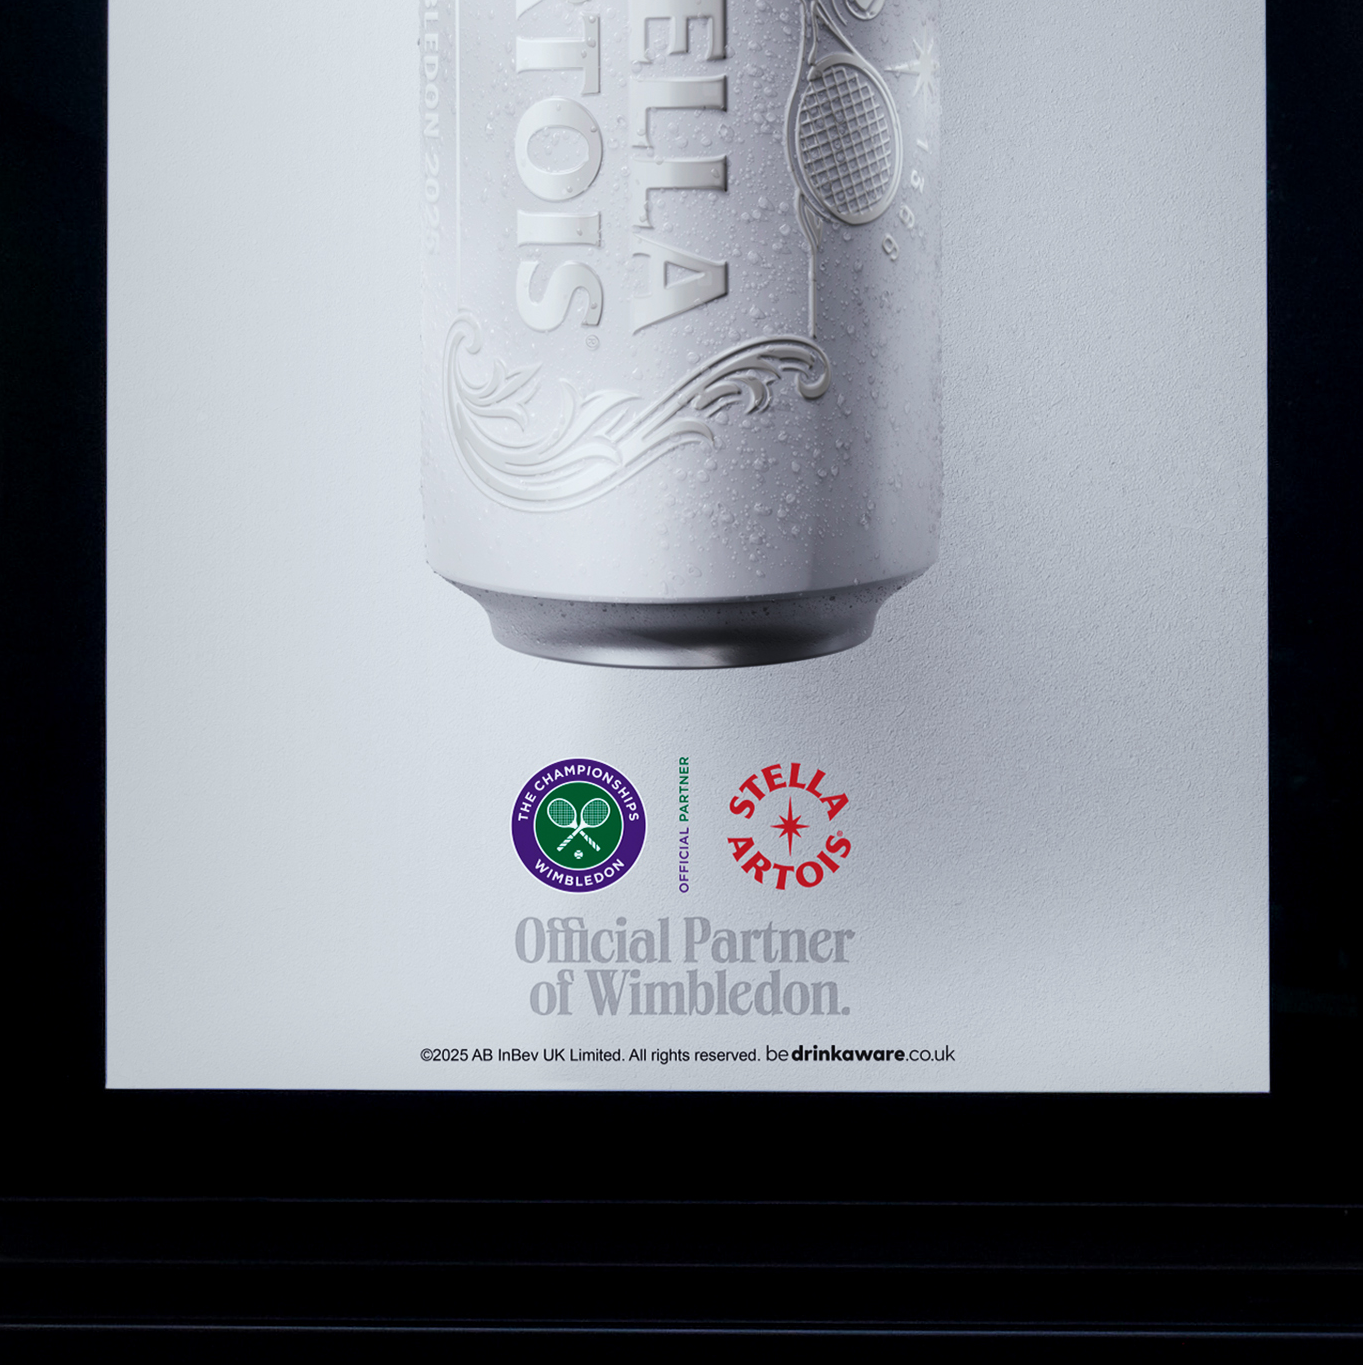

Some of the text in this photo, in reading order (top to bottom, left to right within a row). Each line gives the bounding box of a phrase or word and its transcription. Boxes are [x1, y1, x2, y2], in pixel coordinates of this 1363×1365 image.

[518, 764, 640, 822] THE CHAMPIONSHIPS
[729, 762, 850, 822] STELLA
[679, 757, 689, 893] OFFICIAL PARTNER
[534, 858, 625, 887] WIMBLEDON
[515, 915, 856, 965] Official Partner
[530, 968, 851, 1016] of Wimbledon.
[472, 1048, 493, 1062] AB
[498, 1048, 538, 1062] InBev
[543, 1048, 565, 1062] UK
[570, 1048, 625, 1062] Limited.
[629, 1048, 647, 1062] All
[651, 1048, 690, 1065] rights
[694, 1048, 760, 1062] reserved.
